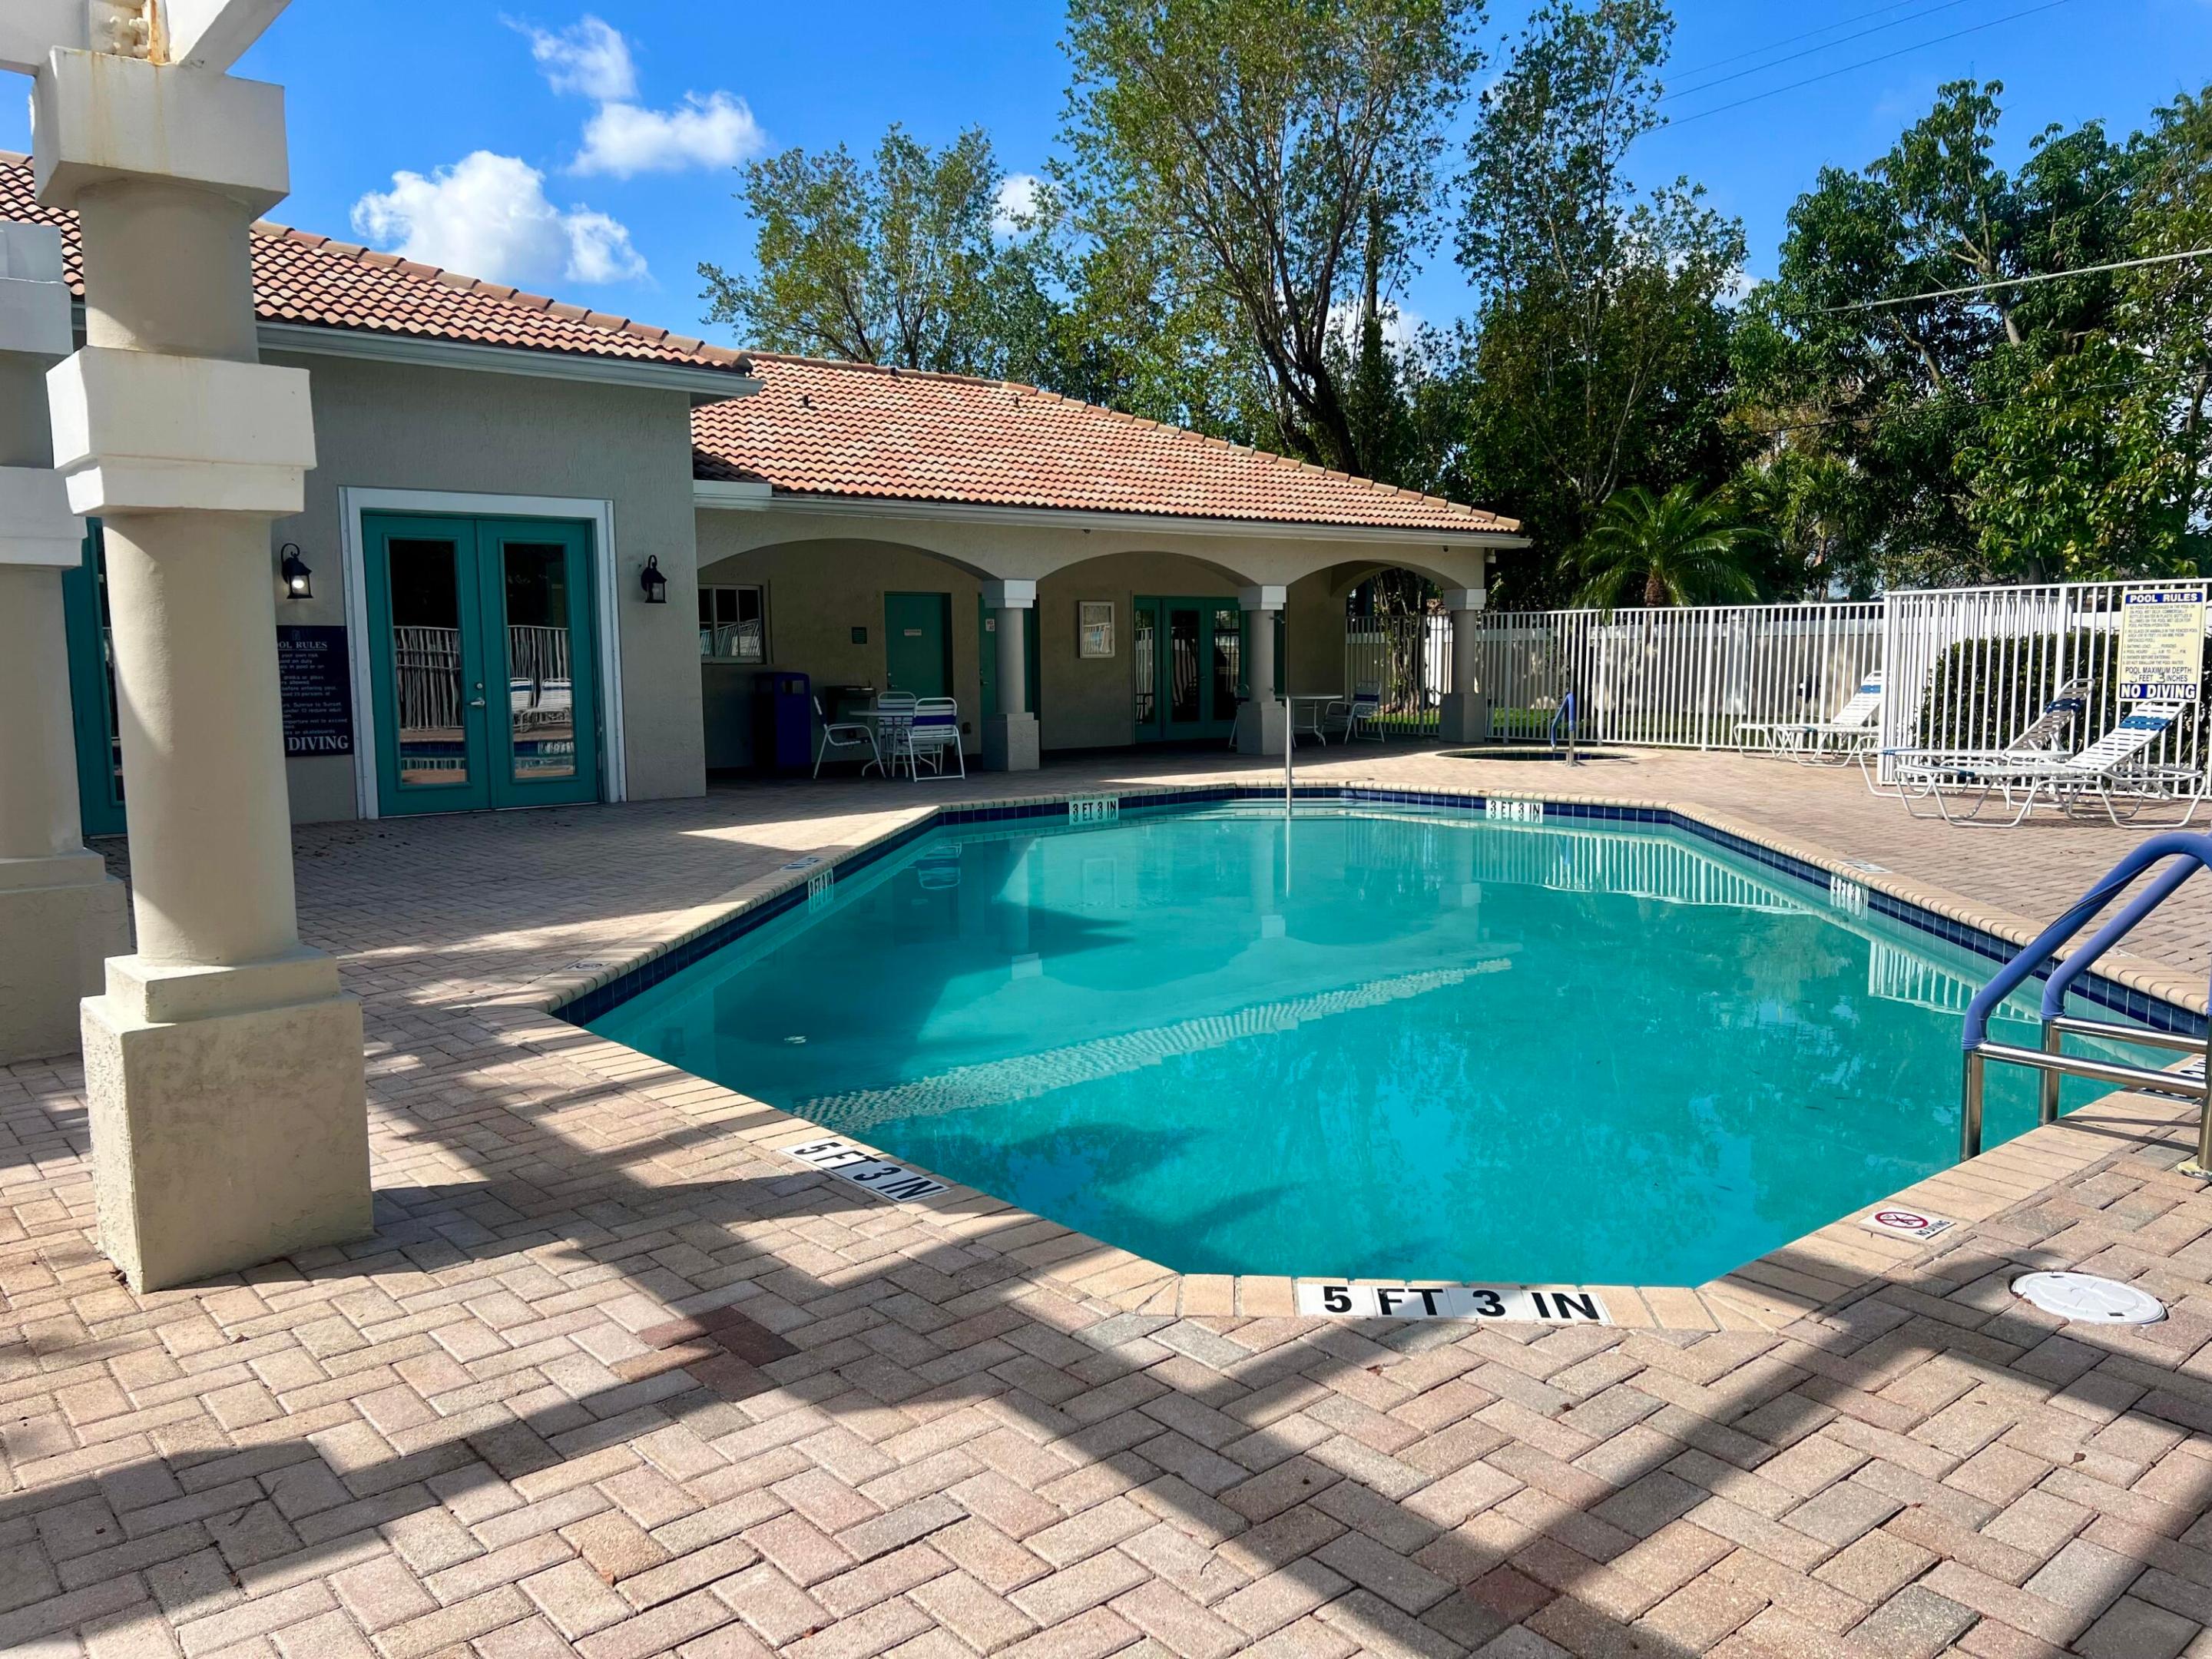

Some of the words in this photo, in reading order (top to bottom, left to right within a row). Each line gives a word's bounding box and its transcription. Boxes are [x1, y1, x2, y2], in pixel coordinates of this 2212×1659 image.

[2130, 594, 2158, 603] POOL
[2163, 593, 2197, 602] RULES
[2121, 684, 2141, 698] NO
[2147, 684, 2196, 699] DIVING
[287, 736, 349, 751] DIVING
[794, 1141, 842, 1154] 5
[813, 1151, 881, 1170] FT
[853, 1167, 902, 1181] 3
[876, 1177, 944, 1200] IN
[1324, 1286, 1352, 1313] 5
[1377, 1288, 1444, 1316] FT
[1472, 1290, 1505, 1317] 3
[1532, 1292, 1600, 1320] IN
